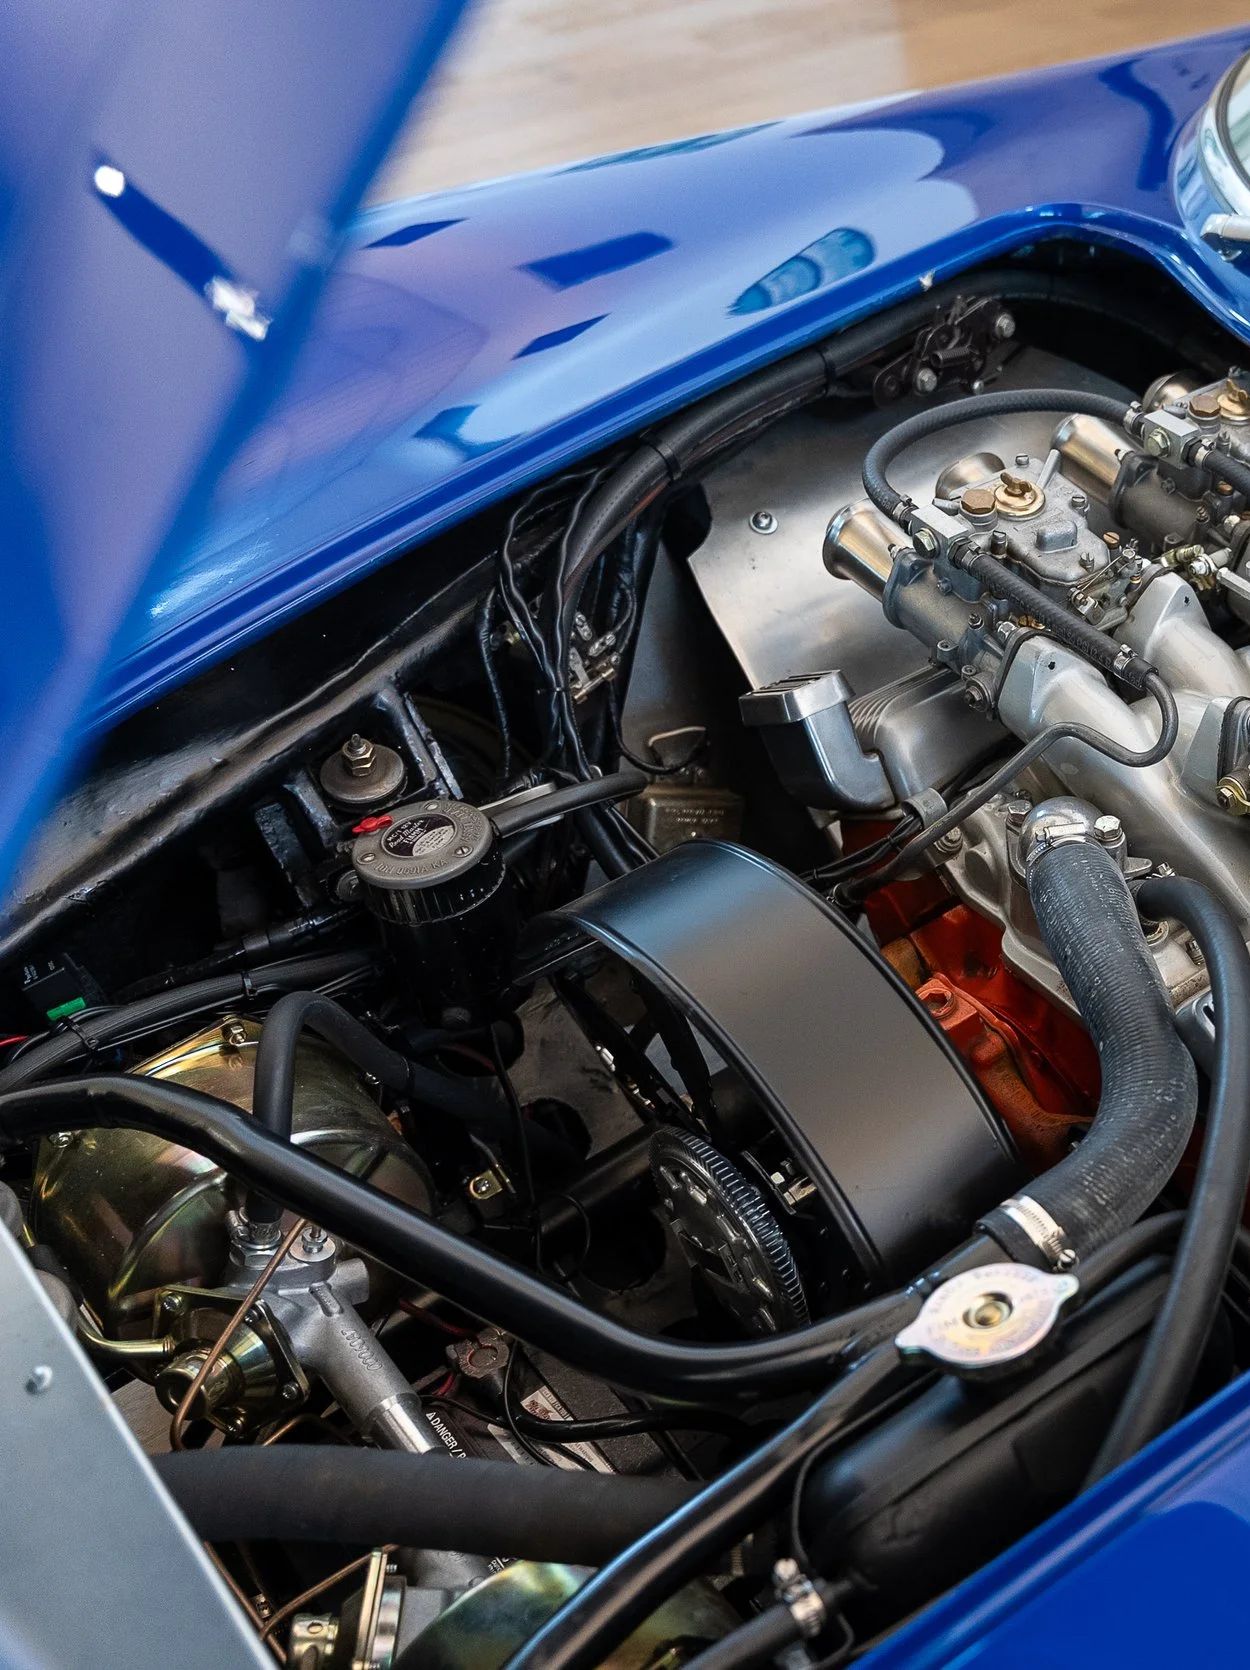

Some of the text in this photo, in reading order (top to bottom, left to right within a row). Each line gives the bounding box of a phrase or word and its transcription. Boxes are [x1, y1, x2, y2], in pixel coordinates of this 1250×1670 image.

[388, 834, 404, 849] Road
[402, 819, 425, 837] Master
[430, 1417, 458, 1450] DANGER
